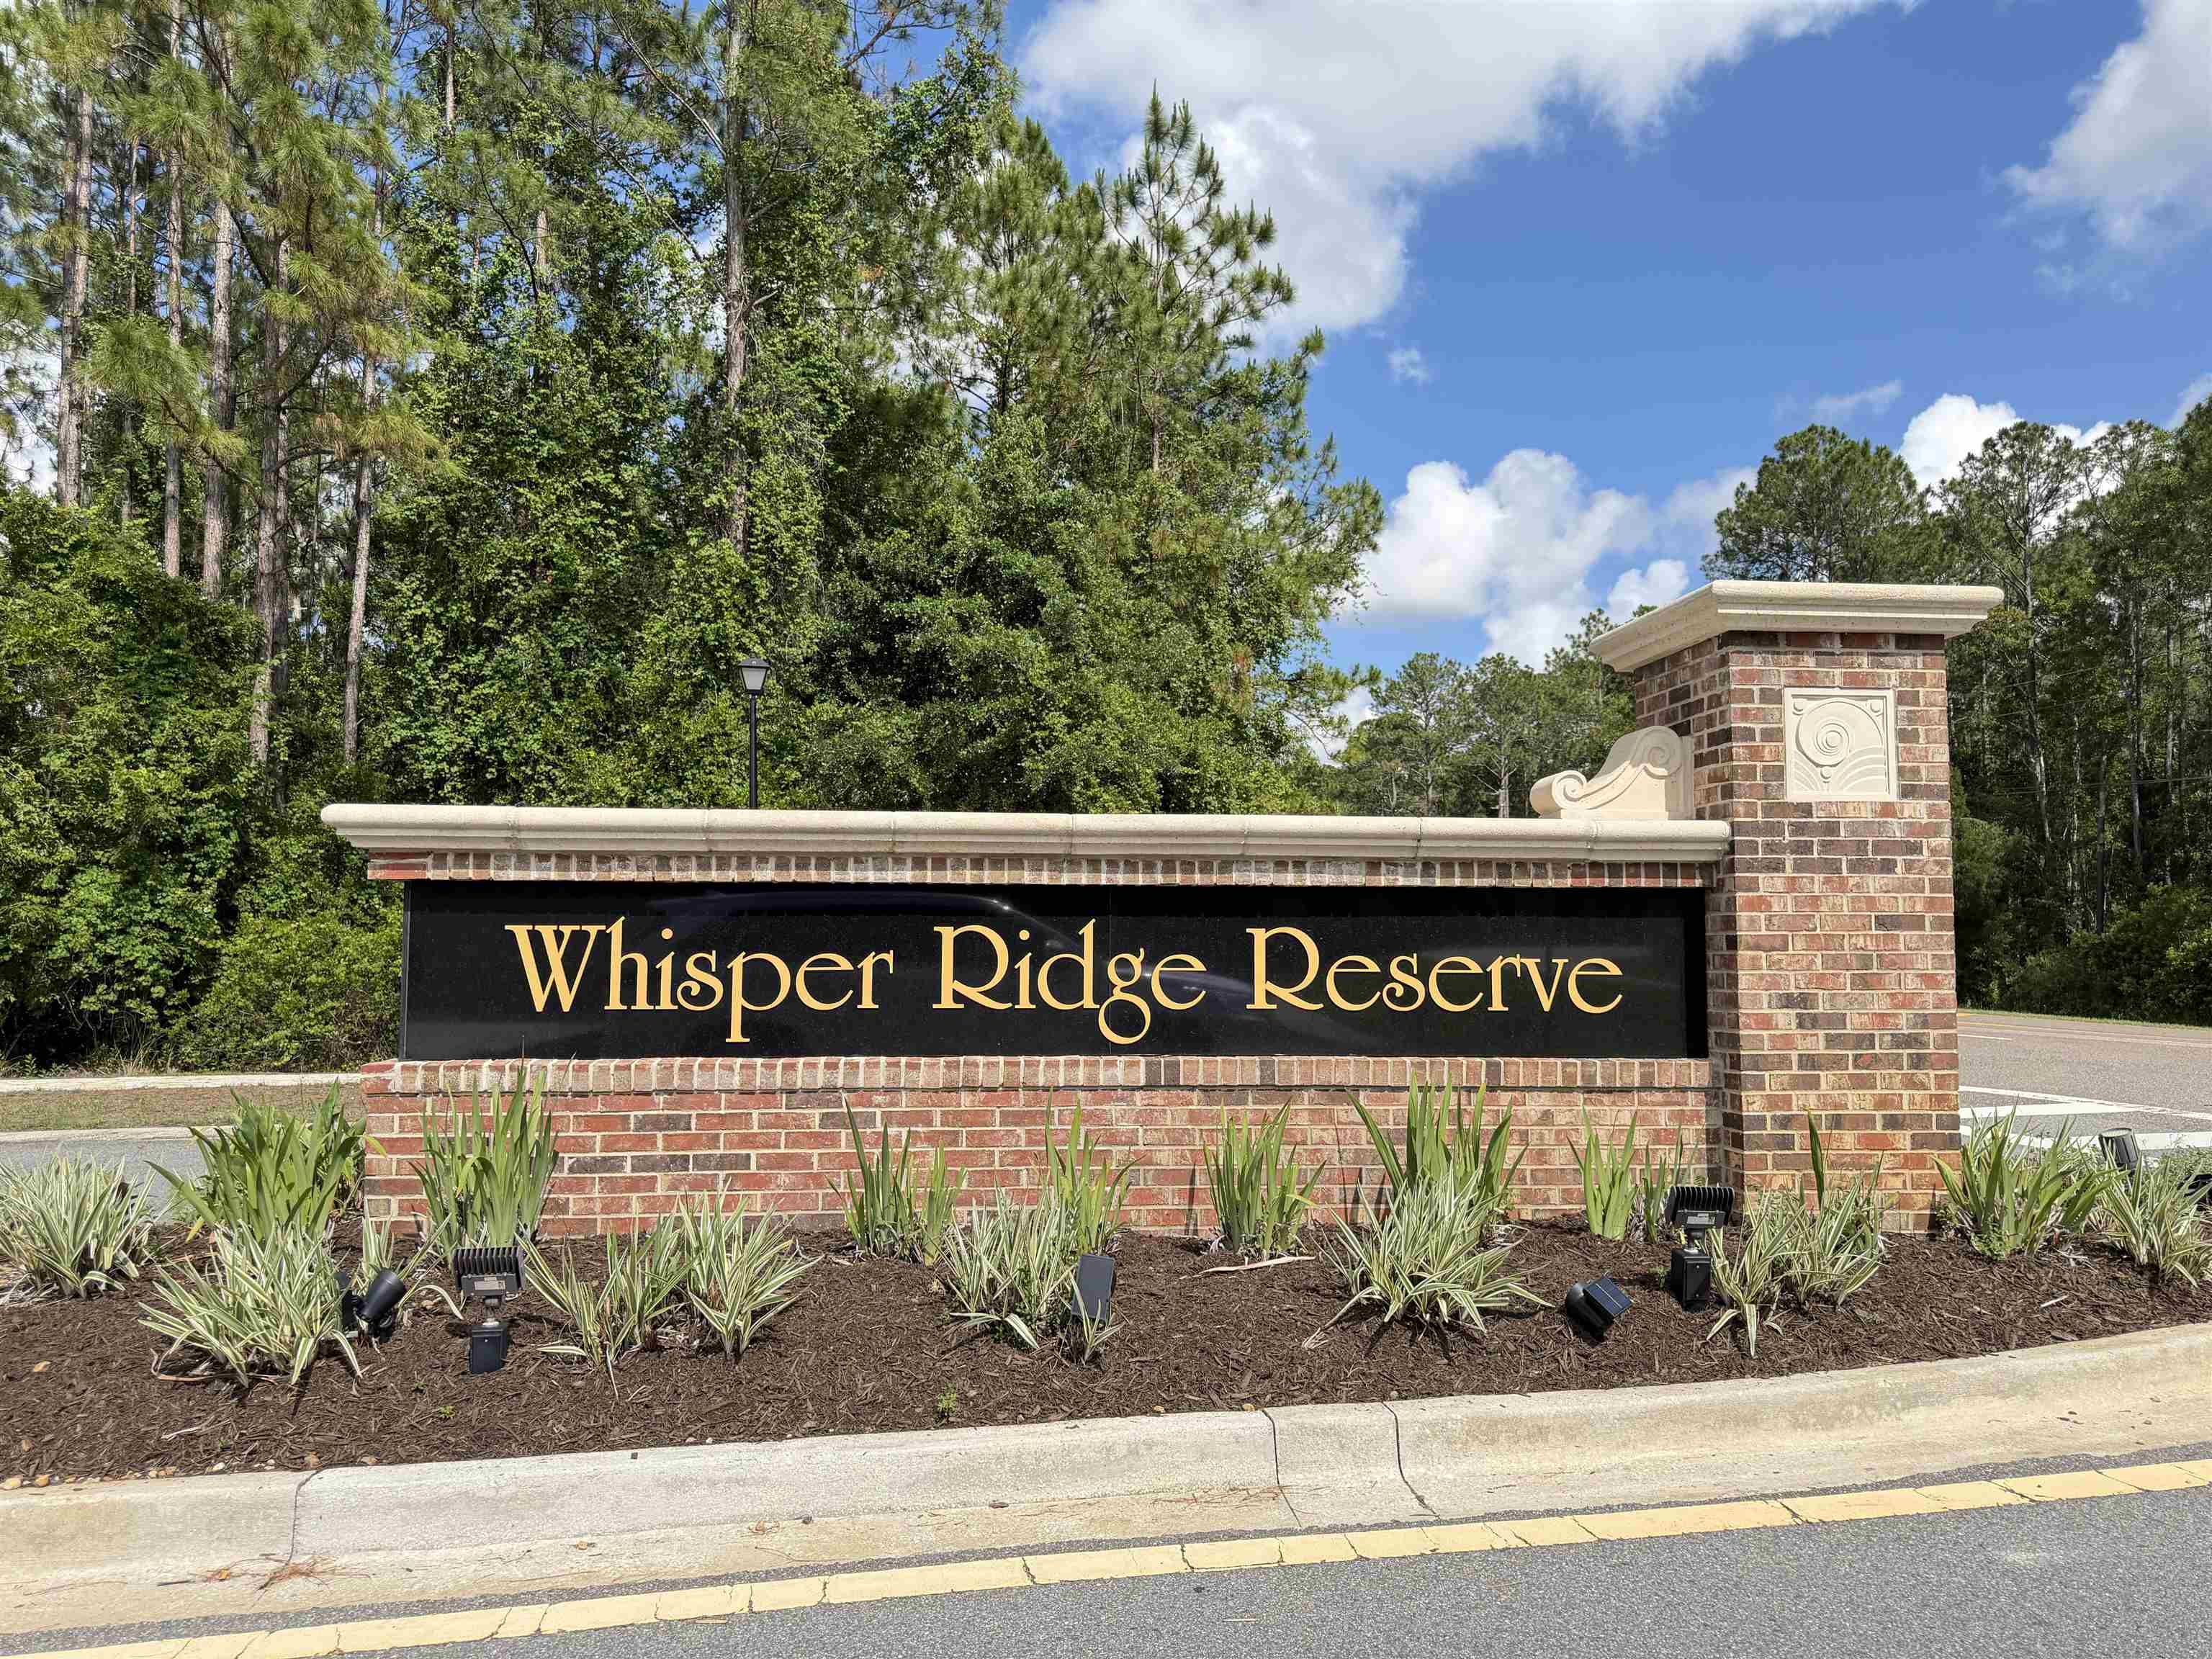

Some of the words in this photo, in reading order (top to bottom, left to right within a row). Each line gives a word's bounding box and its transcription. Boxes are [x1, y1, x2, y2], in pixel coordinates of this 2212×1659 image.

[505, 917, 894, 1043] Whisper
[932, 917, 1207, 1046] Ridge
[1246, 927, 1624, 1014] Reserve
